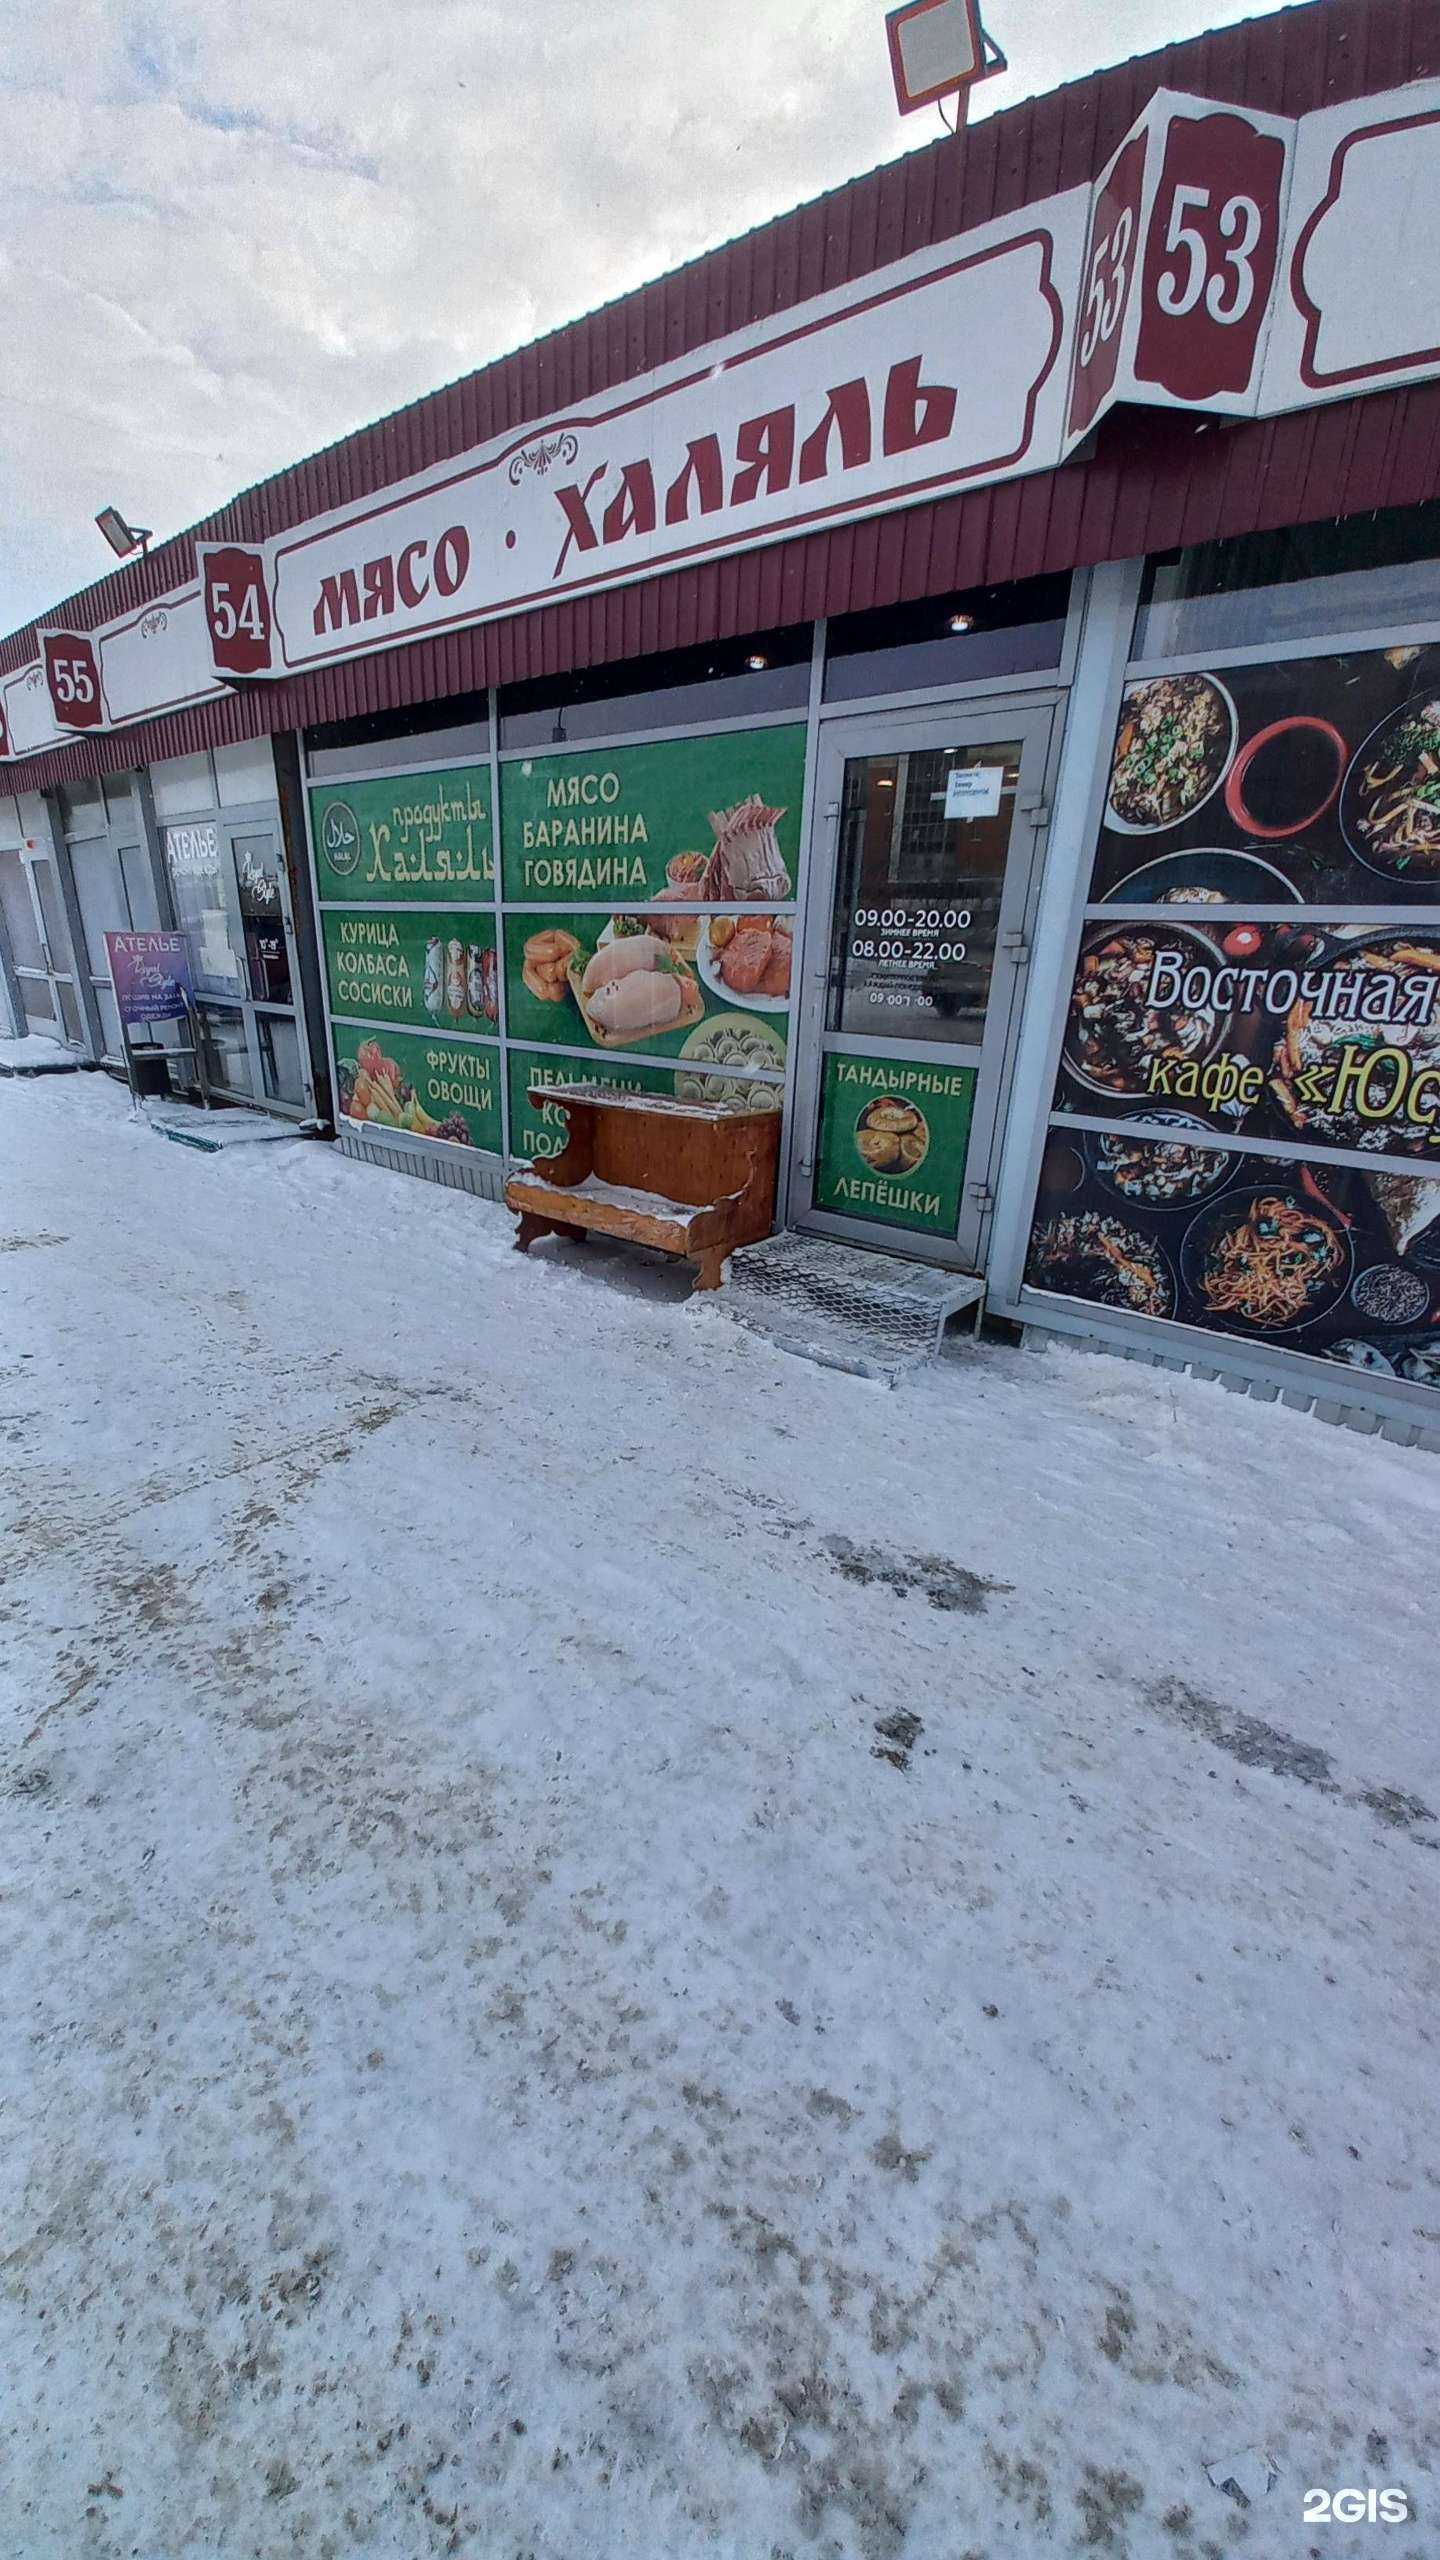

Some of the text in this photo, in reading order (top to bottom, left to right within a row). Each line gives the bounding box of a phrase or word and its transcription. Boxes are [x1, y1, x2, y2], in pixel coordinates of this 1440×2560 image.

[1157, 184, 1262, 325] 53
[1081, 208, 1133, 368] 53
[313, 355, 958, 636] МЯСО ХАЛЯЛЬ
[211, 582, 266, 640] 54
[53, 659, 94, 704] 55
[547, 772, 620, 808] МЯСО
[166, 828, 217, 862] АТЕЛЬЕ
[523, 813, 648, 849] БАРАНИНА
[523, 856, 647, 889] ГОВЯДИНА
[340, 922, 400, 948] КУРИЦА
[854, 909, 971, 928] 09.00-20.00
[912, 929, 940, 938] ВРЕМЯ
[114, 935, 180, 953] АТЕЛЬЕ
[852, 940, 966, 960] 08.00-22.00
[336, 951, 410, 978] КОЛБАСА
[338, 980, 413, 1008] СОСИСКИ
[1145, 951, 1439, 1025] Восточная
[427, 1049, 490, 1080] ФРУКТЫ
[837, 1063, 963, 1096] ТАНДЫРНЫЕ
[427, 1079, 493, 1111] ОВОЩИ
[1147, 1053, 1264, 1113] кафе
[833, 1176, 941, 1216] ЛЕПЁШКИ
